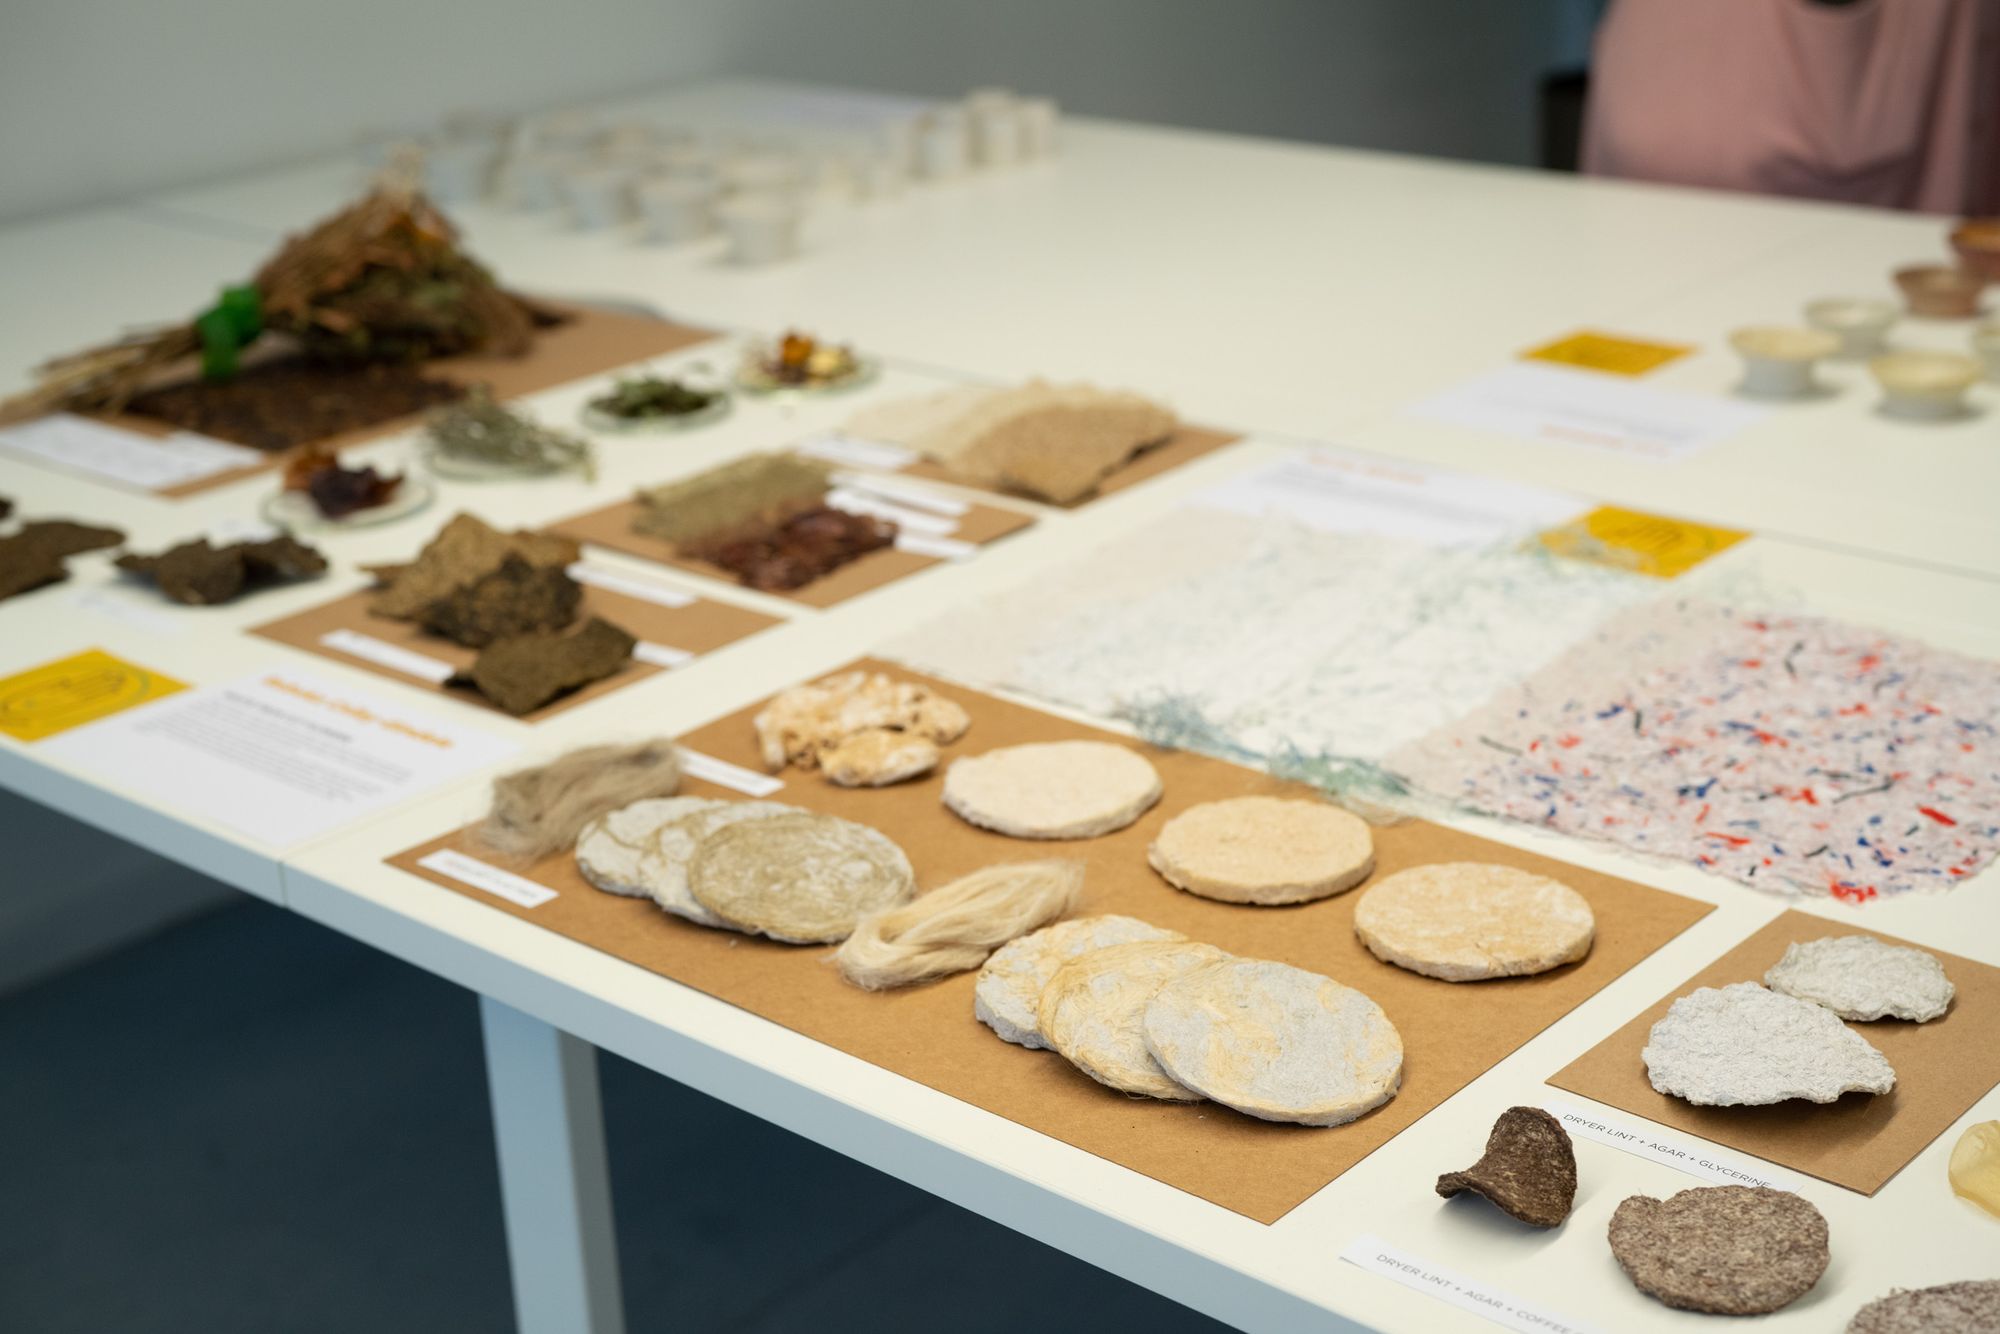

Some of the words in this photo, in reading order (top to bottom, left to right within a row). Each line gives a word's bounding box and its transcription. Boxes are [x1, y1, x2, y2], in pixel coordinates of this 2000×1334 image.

[1563, 1114, 1606, 1132] DRYER
[1607, 1128, 1637, 1142] LINT
[1648, 1143, 1686, 1159] AGAR
[1699, 1159, 1772, 1188] GLYCERINE
[1376, 1254, 1421, 1275] DRYER
[1421, 1272, 1452, 1288] LINT
[1464, 1290, 1504, 1309] AGAR
[1516, 1310, 1573, 1334] COFFEE
